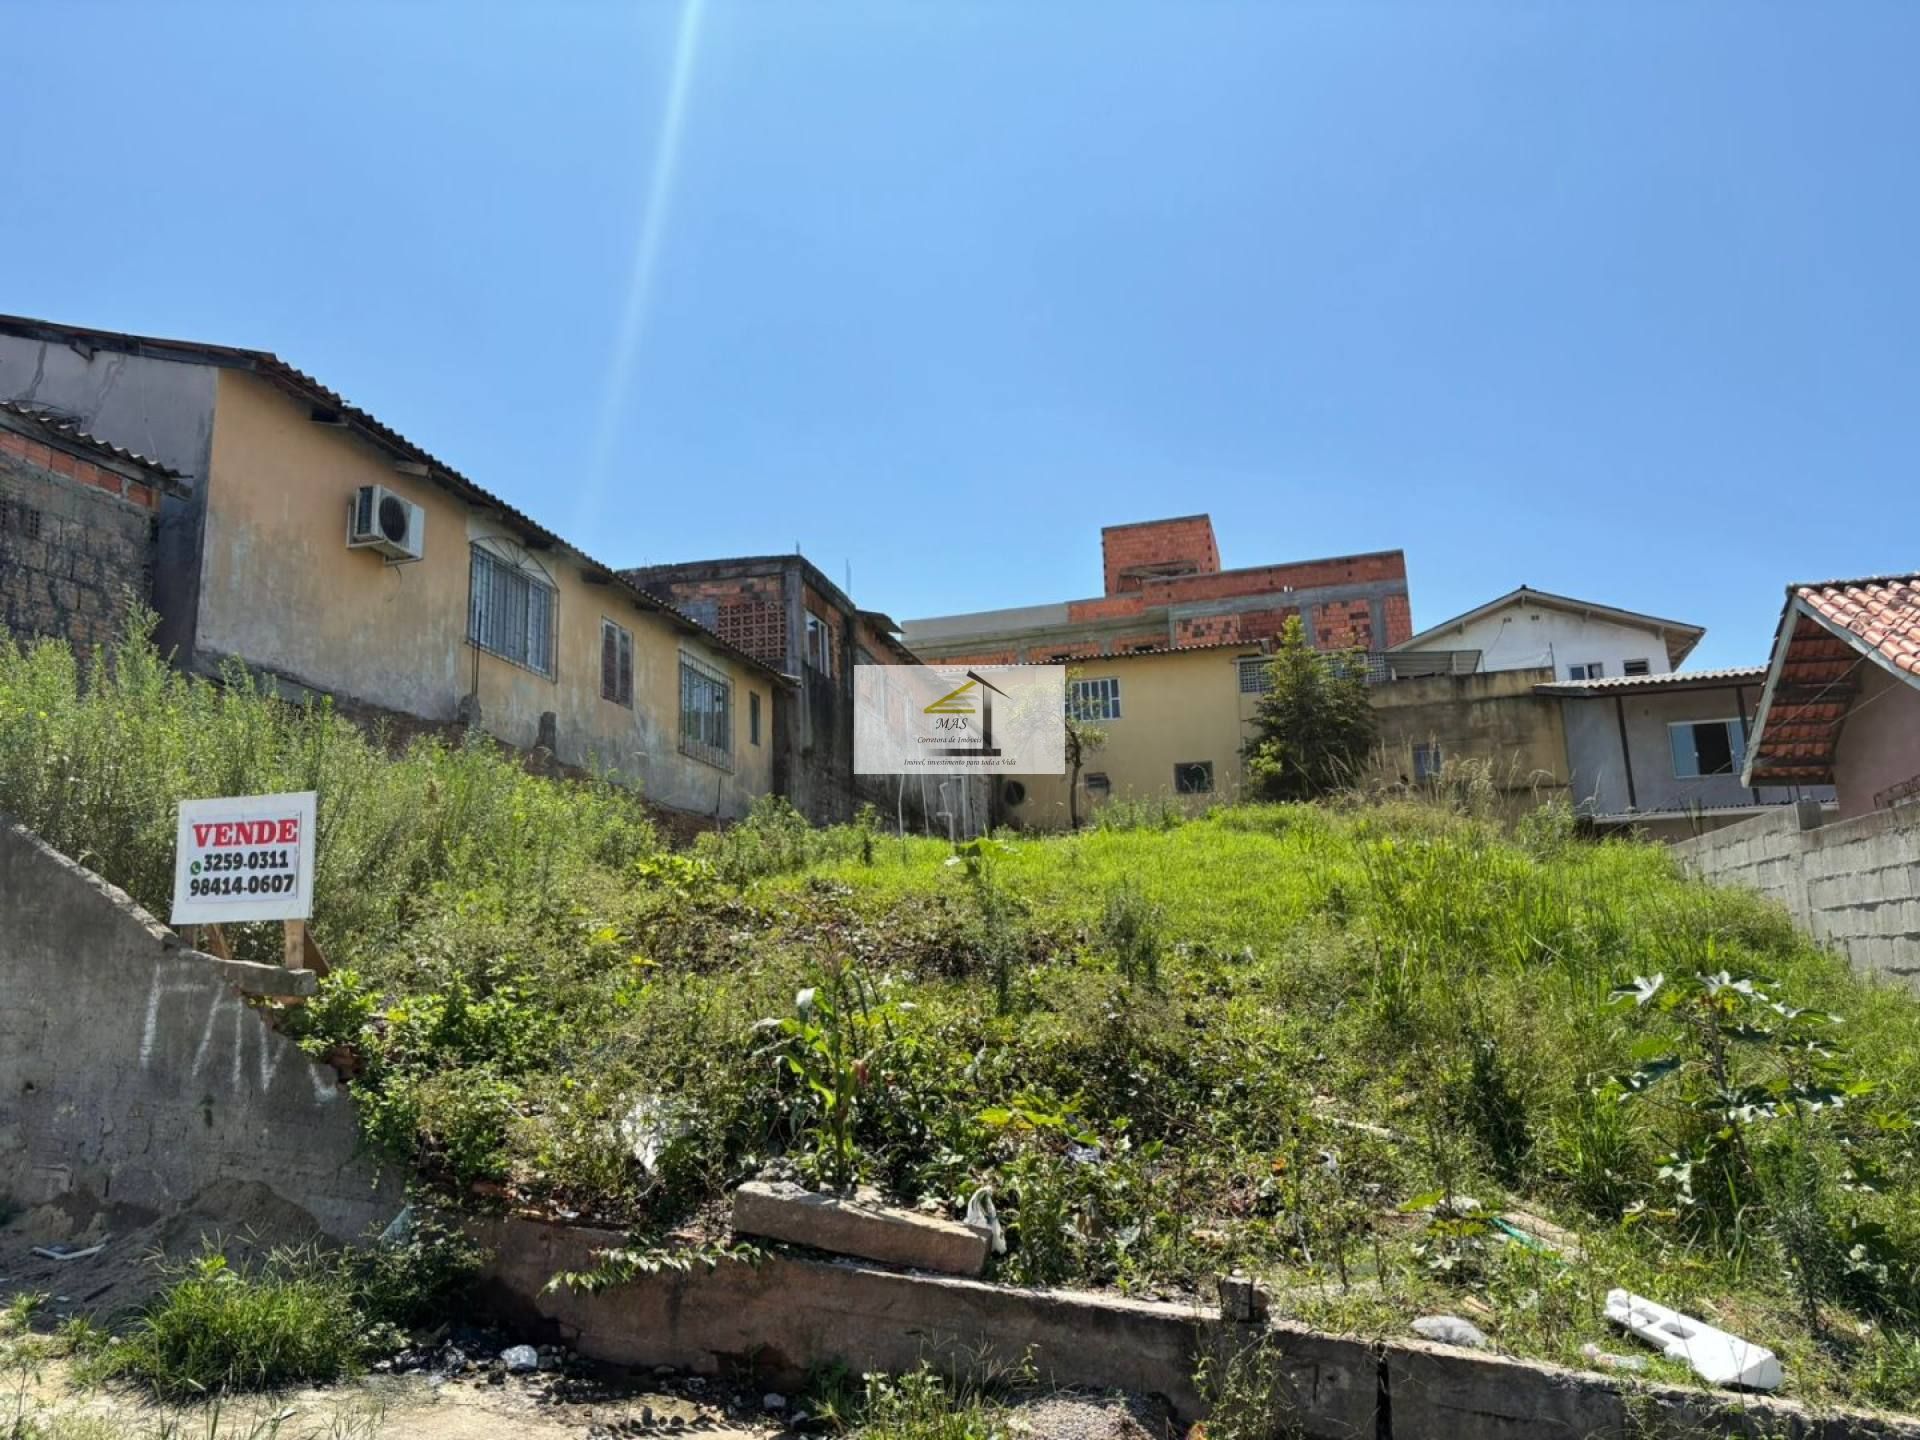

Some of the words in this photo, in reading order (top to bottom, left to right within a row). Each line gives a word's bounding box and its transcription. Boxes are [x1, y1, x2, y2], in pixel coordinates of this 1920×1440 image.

[192, 819, 298, 848] VENDE
[203, 850, 288, 872] 3259-0311
[190, 874, 294, 896] 98414-0607
